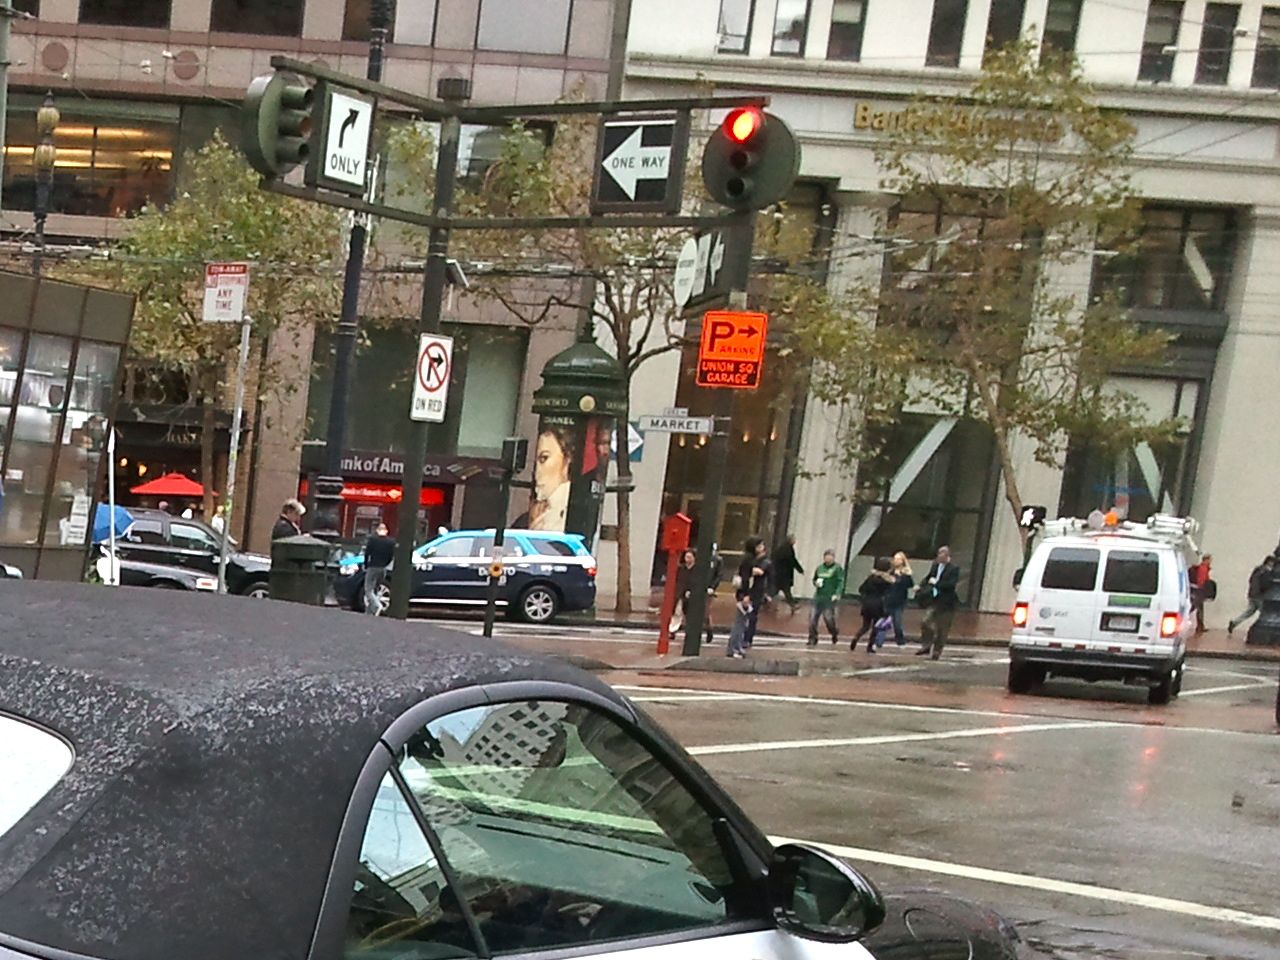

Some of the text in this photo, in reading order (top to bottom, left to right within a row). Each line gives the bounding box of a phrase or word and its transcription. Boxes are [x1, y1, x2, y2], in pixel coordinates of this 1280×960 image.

[330, 153, 361, 176] ONLY
[611, 156, 666, 169] ONE WAY
[217, 289, 233, 298] ANY
[215, 300, 232, 311] TIME
[701, 361, 735, 372] UNION
[707, 373, 749, 384] GARAGE
[415, 397, 443, 413] ON RED
[650, 418, 701, 431] MARKET
